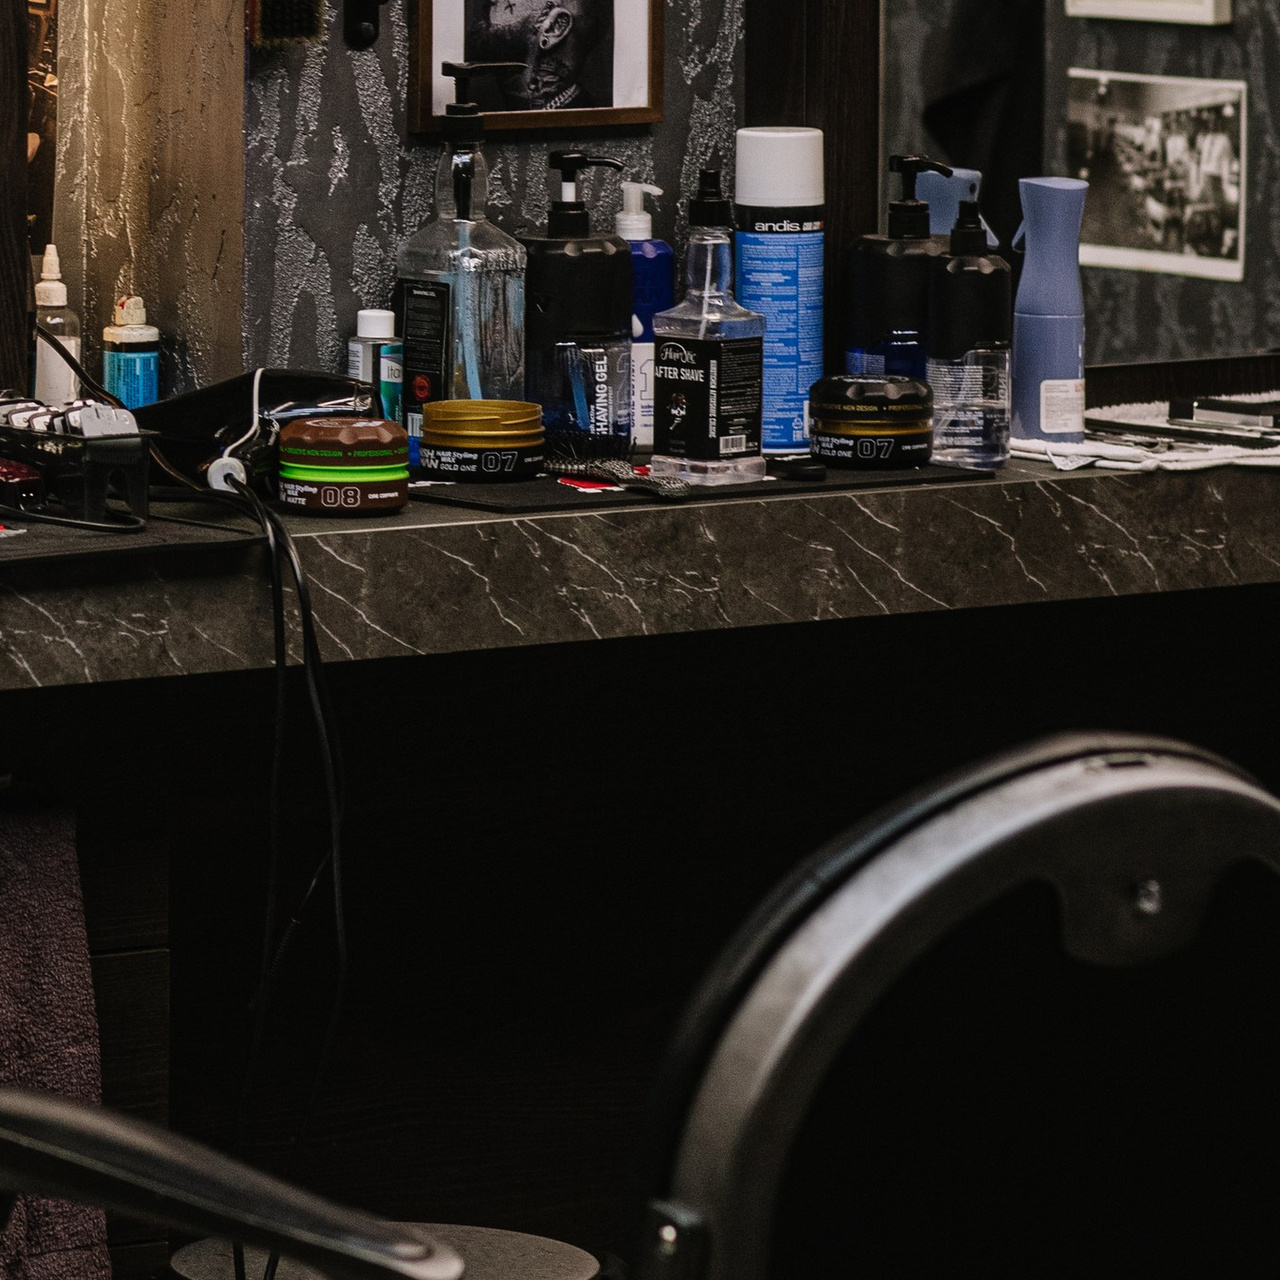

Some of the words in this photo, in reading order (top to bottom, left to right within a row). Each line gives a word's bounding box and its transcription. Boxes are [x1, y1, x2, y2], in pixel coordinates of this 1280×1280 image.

[754, 219, 801, 232] andis
[595, 355, 608, 382] GEL
[655, 365, 679, 380] AFTER
[680, 368, 705, 383] SHAVE
[830, 436, 855, 447] Styling
[837, 449, 853, 459] ONE
[857, 438, 895, 459] 07
[436, 450, 452, 459] HAIR
[452, 450, 479, 461] Styling
[481, 450, 518, 473] 07
[439, 463, 459, 472] GOLD
[459, 464, 478, 472] ONE
[286, 496, 307, 506] MATTE
[320, 485, 361, 508] 08
